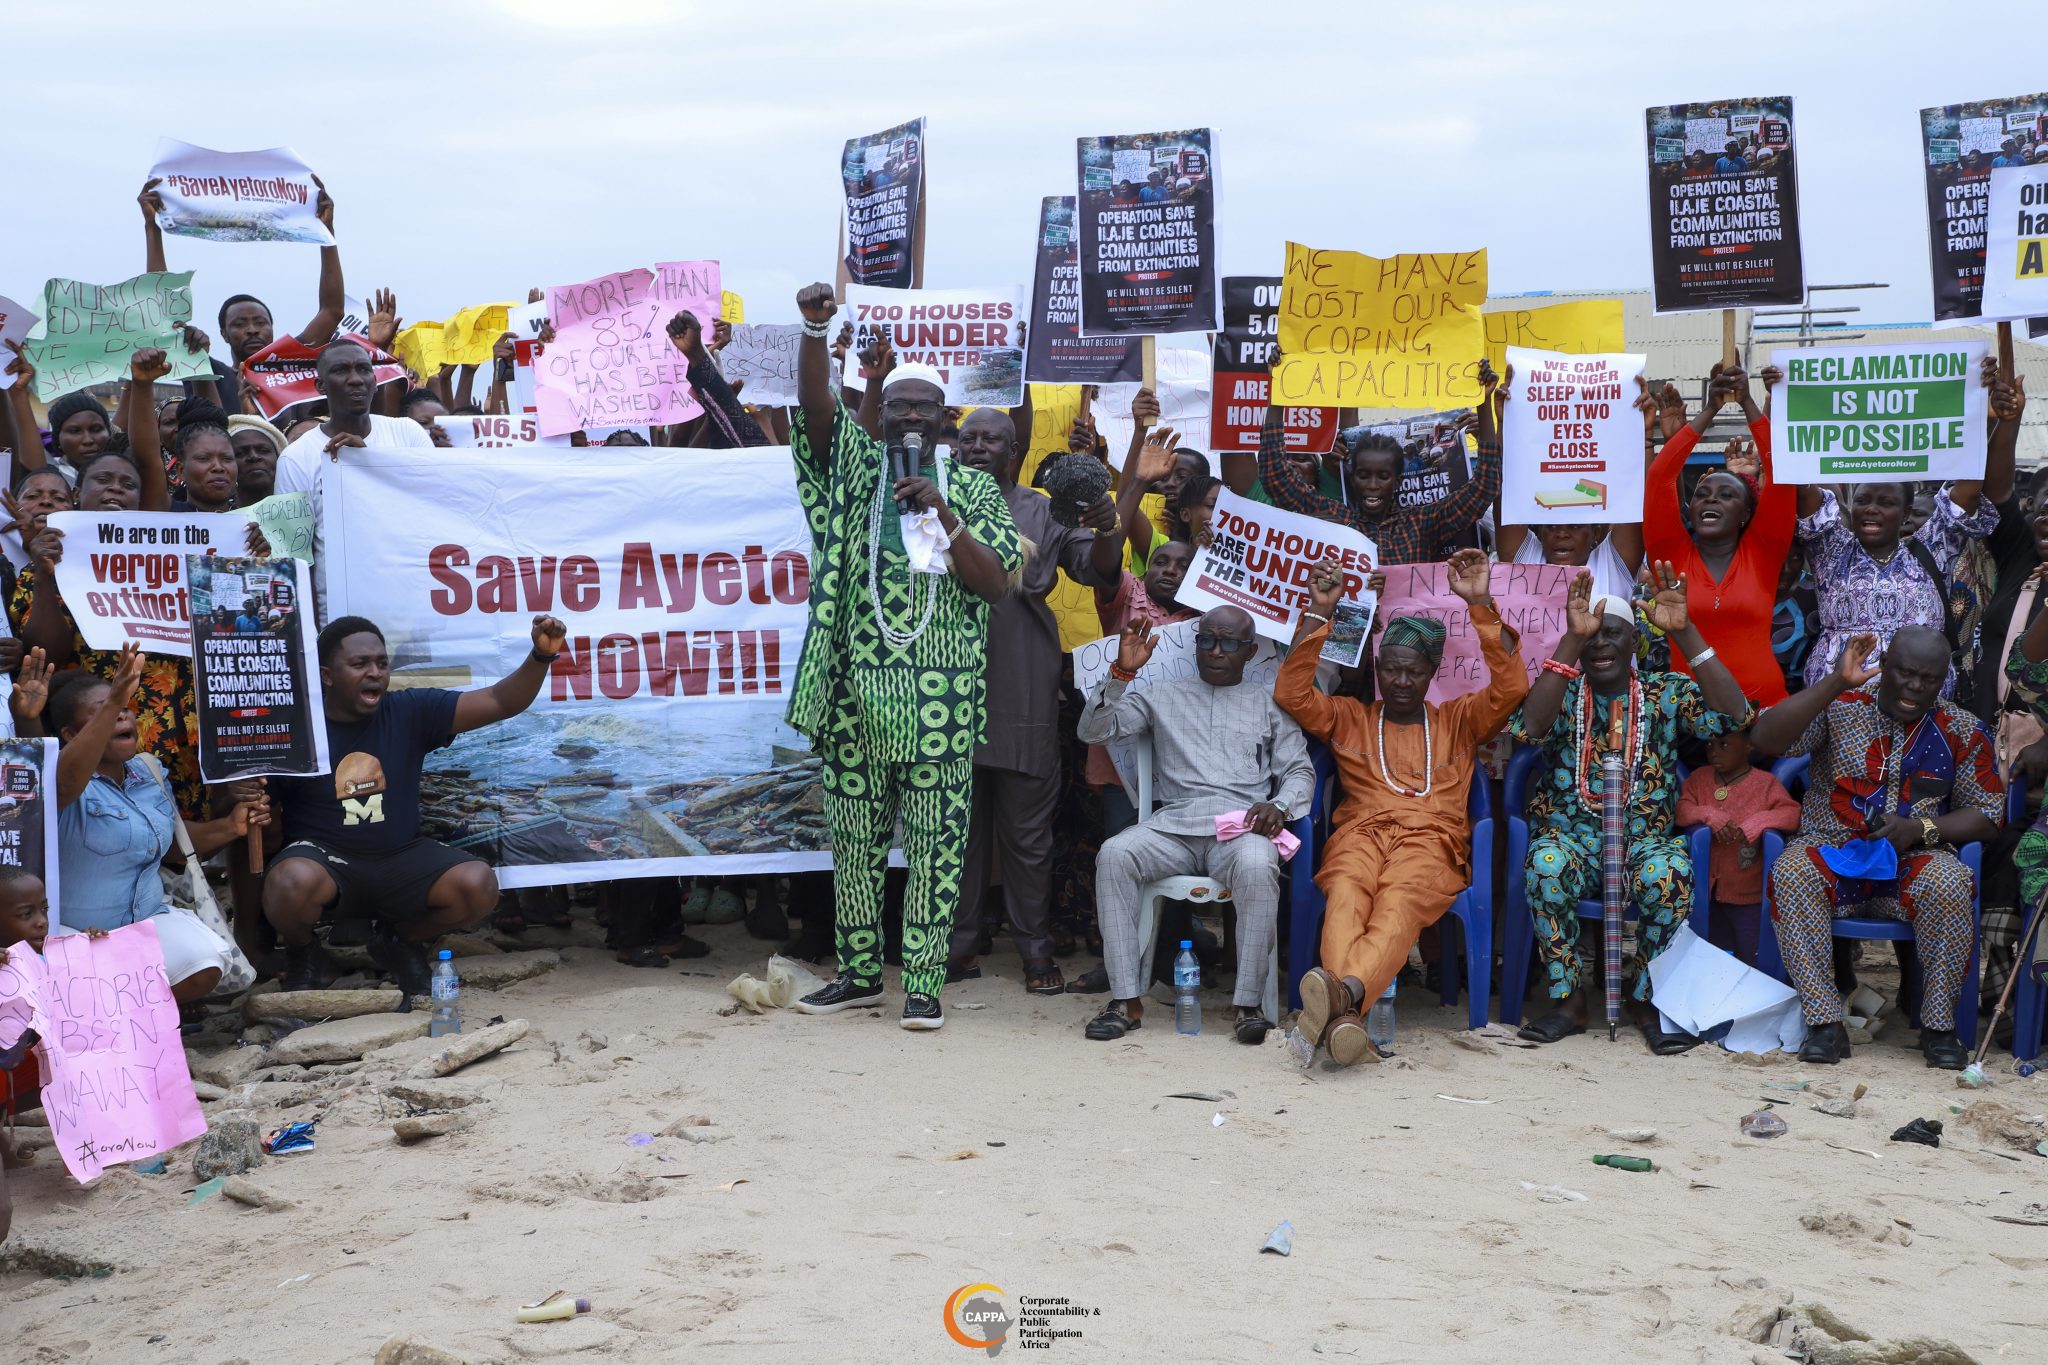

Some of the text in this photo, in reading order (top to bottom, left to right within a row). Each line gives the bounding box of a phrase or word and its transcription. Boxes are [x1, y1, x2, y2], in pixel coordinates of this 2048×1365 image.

[168, 174, 307, 206] #SaveAyetoroNow
[848, 186, 908, 208] OPERATION SAVE
[1670, 176, 1778, 198] OPERATION SAVE
[872, 198, 907, 218] COASTAL
[1098, 205, 1195, 225] OPERATION SAVE
[1669, 192, 1780, 216] ILAJE COASTAL
[849, 213, 907, 236] OMMUNITIES
[1098, 221, 1197, 241] ILAJE COASTAL
[1670, 210, 1781, 234] COMMUNITIES
[866, 228, 907, 246] EXTINCTION
[1099, 238, 1198, 258] COMMUNITIES
[1670, 228, 1782, 248] FROM EXTINCTION
[1948, 235, 1984, 252] FROM
[881, 253, 899, 262] SILENT
[1713, 247, 1735, 255] PROTEST
[2020, 241, 2044, 276] A
[1098, 255, 1199, 273] FROM EXTINCTION
[1289, 242, 1480, 292] WE HAVE
[1680, 258, 1774, 273] WE WILL NOT BE SILENT
[1958, 268, 1970, 276] WE
[554, 268, 709, 328] MORE THAN
[1107, 285, 1193, 297] WE WILL NOT BE SILENT
[1253, 285, 1283, 307] OV
[90, 287, 191, 334] FACTORIES
[857, 302, 1013, 322] 700 HOUSES
[1287, 287, 1466, 324] LOST OUR
[342, 315, 362, 332] Oil
[592, 305, 661, 347] 85%
[1047, 312, 1076, 323] FROM
[1248, 314, 1278, 337] 5,0
[1484, 311, 1548, 345] UR
[894, 323, 1008, 348] UNDER
[1105, 338, 1126, 346] SILENT
[1303, 323, 1432, 356] COPING
[551, 344, 640, 376] OF OUR
[903, 351, 981, 367] WATER
[1544, 360, 1606, 372] WE CAN
[1788, 352, 1967, 382] RECLAMATION
[575, 364, 687, 395] HAS BEE
[1280, 360, 1484, 399] CAPACITIES
[1530, 370, 1619, 385] NO LONGER
[1233, 380, 1268, 400] ARE
[1527, 384, 1621, 402] SLEEP WITH
[569, 393, 661, 418] WASHED
[1537, 403, 1610, 421] OUR TWO
[1832, 389, 1919, 415] IS NOT
[1226, 406, 1322, 428] HOMLESS
[1553, 423, 1593, 440] EYES
[1787, 421, 1964, 453] IMPOSSIBLE
[1548, 442, 1598, 459] CLOSE
[1832, 460, 1917, 469] #SaveAyetoroNow
[1423, 472, 1451, 488] SAVE
[98, 523, 210, 545] We are on the
[1214, 532, 1246, 553] ARE
[1216, 509, 1372, 574] 700 HOUSES
[1209, 543, 1244, 566] NOW
[90, 553, 179, 589] verge
[429, 543, 601, 616] Save
[1245, 545, 1363, 601] UNDR
[1409, 563, 1569, 597] NERIA
[1204, 557, 1314, 610] THE WATE
[1208, 582, 1280, 617] #SaveAyetoroNow
[204, 639, 288, 654] OPERATION SAVE
[205, 656, 290, 673] ILAJE COASTAL
[550, 629, 782, 701] NOW!!!
[208, 674, 291, 692] COMMUNITIES
[209, 692, 294, 708] FROM EXTINCTION
[217, 724, 290, 735] WE WILL NOT BE SILENT
[342, 793, 385, 826] M
[61, 1009, 158, 1059] BEEN
